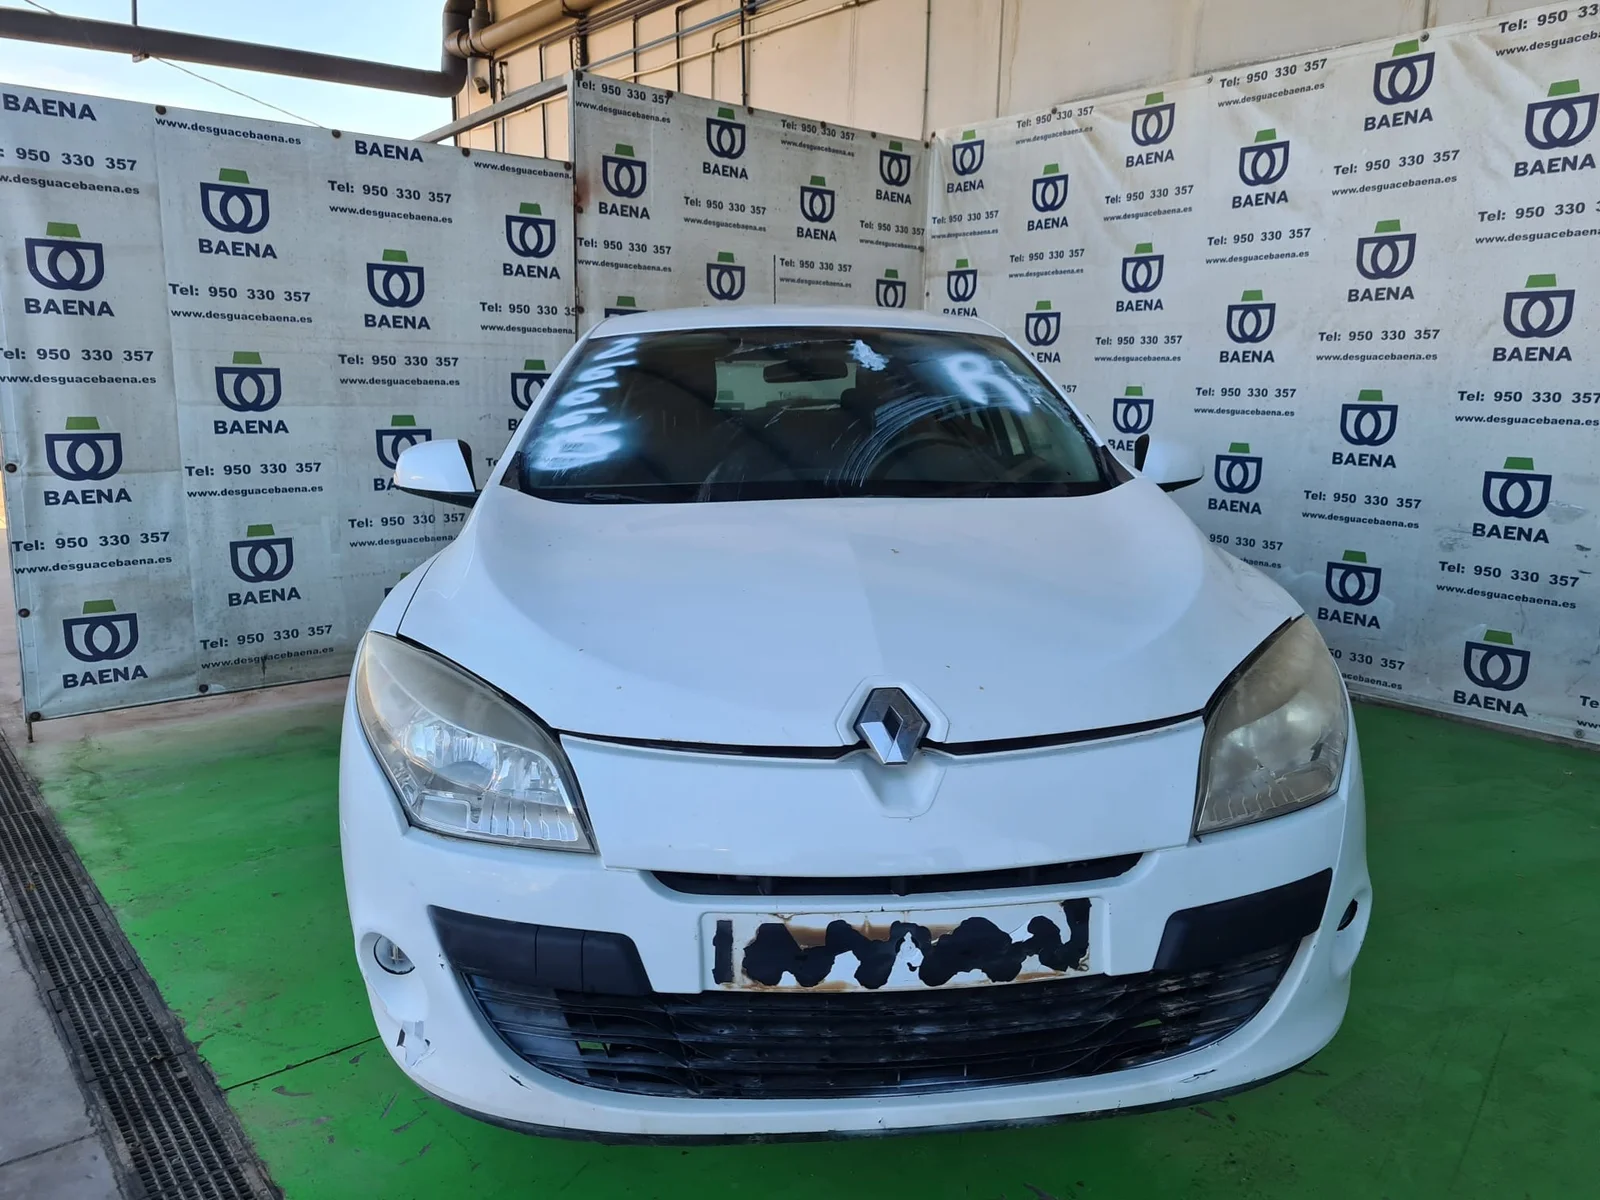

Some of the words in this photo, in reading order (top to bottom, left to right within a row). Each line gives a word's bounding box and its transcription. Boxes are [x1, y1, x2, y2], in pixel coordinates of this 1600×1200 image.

[1499, 19, 1527, 33] Tel:
[1538, 10, 1567, 26] 950
[1220, 77, 1240, 88] Tel:
[1247, 71, 1268, 83] 950
[1275, 65, 1297, 77] 330
[1304, 58, 1327, 72] 357
[602, 84, 621, 96] 950
[627, 89, 646, 100] 330
[3, 93, 96, 121] BAENA
[1364, 108, 1433, 131] BAENA
[155, 117, 302, 146] www.desguacebaena.es
[16, 148, 50, 162] 950
[62, 153, 94, 167] 330
[105, 158, 136, 171] 357
[355, 140, 423, 162] BAENA
[1126, 149, 1174, 168] BAENA
[703, 162, 748, 180] BAENA
[1334, 164, 1357, 175] Tel:
[1366, 159, 1390, 171] 950
[1399, 154, 1424, 167] 330
[1433, 150, 1460, 163] 357
[1514, 154, 1596, 177] BAENA
[328, 180, 354, 193] Tel:
[363, 185, 388, 197] 950
[396, 188, 420, 200] 330
[429, 192, 451, 203] 357
[947, 179, 984, 193] BAENA
[1105, 195, 1121, 204] Tel:
[1127, 191, 1144, 201] 950
[1150, 188, 1168, 198] 330
[1175, 185, 1194, 196] 357
[1332, 176, 1457, 196] www.desguacebaena.es
[876, 189, 911, 204] BAENA
[1232, 190, 1288, 209] BAENA
[599, 202, 650, 219] BAENA
[684, 196, 701, 207] Tel:
[706, 200, 723, 210] 950
[729, 202, 745, 212] 330
[751, 205, 766, 215] 357
[1478, 210, 1505, 222] Tel:
[1516, 206, 1544, 219] 950
[1555, 202, 1585, 215] 330
[329, 206, 452, 223] www.desguacebaena.es
[1028, 216, 1068, 231] BAENA
[797, 227, 836, 241] BAENA
[1207, 236, 1227, 246] Tel:
[1234, 233, 1254, 244] 950
[1261, 231, 1282, 241] 330
[1289, 228, 1311, 239] 357
[199, 238, 277, 259] BAENA
[578, 238, 598, 248] Tel:
[604, 240, 622, 250] 950
[629, 243, 647, 253] 330
[653, 245, 671, 254] 357
[503, 263, 560, 279] BAENA
[780, 258, 795, 267] Tel:
[800, 260, 814, 269] 950
[819, 262, 833, 271] 330
[838, 264, 852, 272] 357
[168, 283, 199, 296] Tel:
[209, 286, 237, 298] 950
[247, 289, 275, 300] 330
[284, 291, 310, 302] 357
[1348, 286, 1414, 302] BAENA
[24, 298, 114, 316] BAENA
[480, 302, 501, 312] Tel:
[509, 304, 530, 314] 950
[537, 305, 557, 315] 330
[1116, 299, 1163, 312] BAENA
[171, 310, 312, 323] www.desguacebaena.es
[364, 314, 430, 330] BAENA
[1096, 337, 1112, 345] Tel:
[1118, 336, 1134, 345] 950
[1141, 336, 1158, 344] 330
[1164, 335, 1182, 344] 357
[1319, 332, 1341, 341] Tel:
[1349, 331, 1372, 341] 950
[1381, 330, 1405, 340] 330
[1414, 329, 1440, 340] 357
[37, 349, 70, 360] 950
[82, 350, 112, 361] 330
[123, 350, 153, 361] 357
[338, 354, 363, 364] Tel:
[372, 355, 396, 365] 950
[404, 356, 428, 366] 330
[436, 357, 458, 366] 357
[1220, 350, 1274, 362] BAENA
[1316, 353, 1437, 362] www.desguacebaena.es
[1493, 347, 1572, 361] BAENA
[340, 377, 460, 386] www.desguacebaena.es
[940, 350, 1032, 416] R
[1196, 387, 1214, 396] Tel:
[1221, 388, 1240, 396] 950
[1248, 388, 1268, 397] 330
[1275, 388, 1296, 398] 357
[1458, 391, 1484, 401] Tel:
[1494, 392, 1522, 402] 950
[1532, 392, 1561, 403] 330
[1572, 392, 1600, 403] 357
[214, 420, 289, 434] BAENA
[1455, 415, 1599, 426] www.desguacebaena.es
[1332, 452, 1396, 468] BAENA
[185, 466, 214, 476] Tel:
[224, 465, 251, 475] 950
[260, 463, 286, 474] 330
[296, 463, 321, 472] 357
[44, 488, 132, 505] BAENA
[187, 486, 323, 497] www.desguacebaena.es
[1304, 490, 1326, 501] Tel:
[1334, 493, 1356, 503] 950
[1364, 495, 1388, 506] 330
[1397, 498, 1421, 509] 357
[1208, 498, 1261, 514] BAENA
[348, 518, 373, 528] Tel:
[381, 516, 404, 526] 950
[413, 514, 435, 524] 330
[444, 513, 465, 523] 357
[1302, 512, 1419, 528] www.desguacebaena.es
[1472, 523, 1549, 543] BAENA
[11, 540, 44, 552] Tel:
[55, 537, 88, 549] 950
[99, 534, 129, 546] 330
[140, 532, 169, 543] 357
[1210, 534, 1229, 544] 950
[1236, 537, 1255, 547] 330
[1262, 540, 1283, 550] 357
[15, 557, 172, 574] www.desguacebaena.es
[1439, 561, 1465, 573] Tel:
[1474, 566, 1501, 578] 950
[1511, 570, 1539, 582] 330
[1549, 574, 1579, 587] 357
[228, 587, 301, 606] BAENA
[1436, 582, 1577, 610] www.desguacebaena.es
[1318, 607, 1380, 629] BAENA
[200, 638, 228, 650] Tel:
[237, 633, 264, 645] 950
[274, 629, 299, 640] 330
[308, 625, 332, 636] 357
[201, 646, 335, 670] www.desguacebaena.es
[1349, 652, 1372, 664] 330
[1381, 658, 1405, 670] 357
[63, 665, 148, 689] BAENA
[1454, 690, 1528, 717] BAENA
